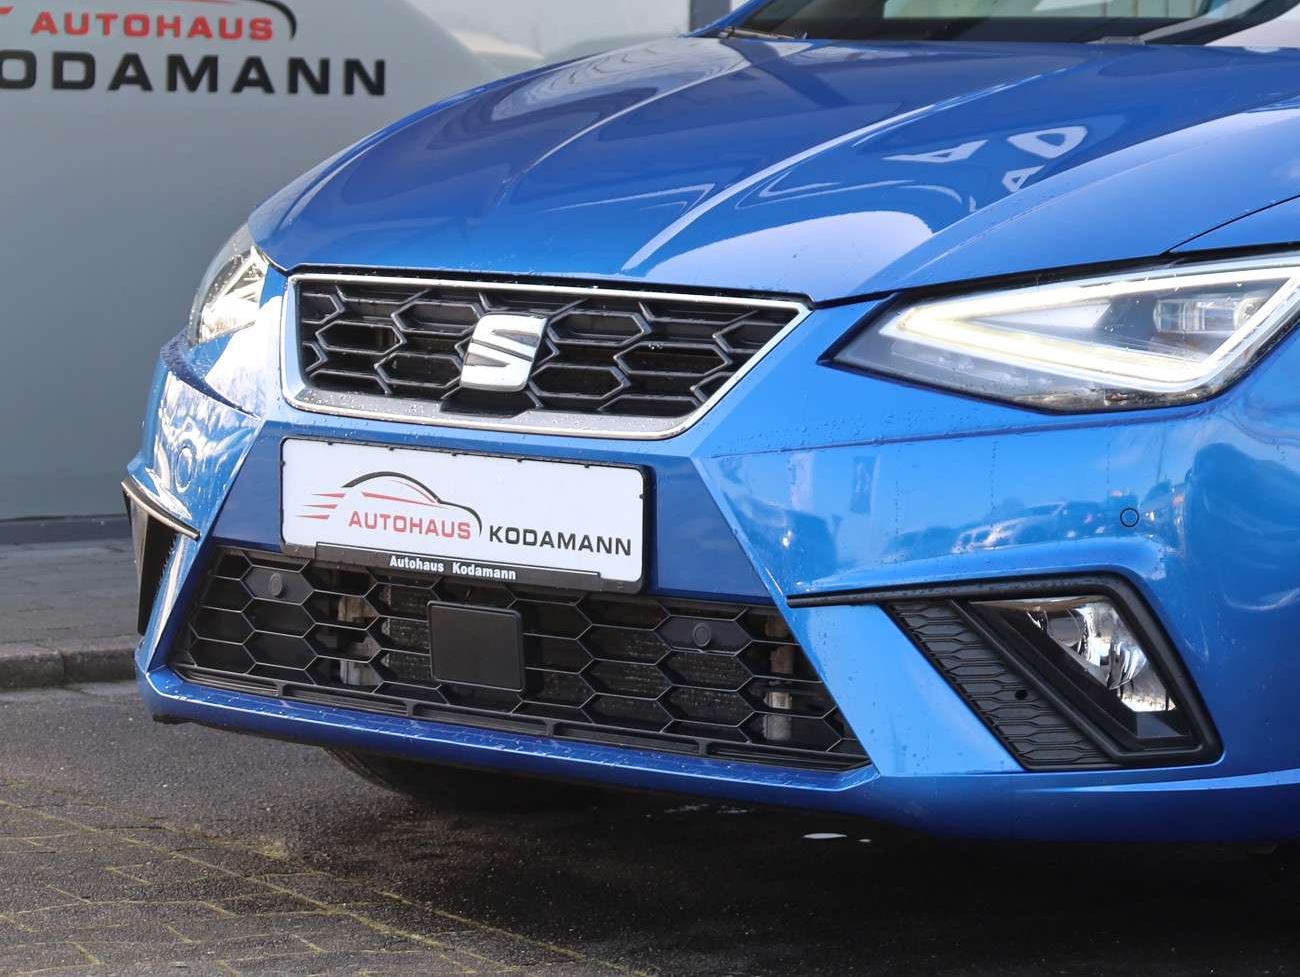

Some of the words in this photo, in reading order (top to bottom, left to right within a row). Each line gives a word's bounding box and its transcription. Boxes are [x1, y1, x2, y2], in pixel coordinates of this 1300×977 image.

[30, 10, 275, 41] AUTOHAUS
[348, 509, 472, 541] AUTOHAUS
[488, 524, 632, 557] KODAMANN
[389, 554, 445, 574] Autohaus
[452, 561, 516, 581] Kodamann
